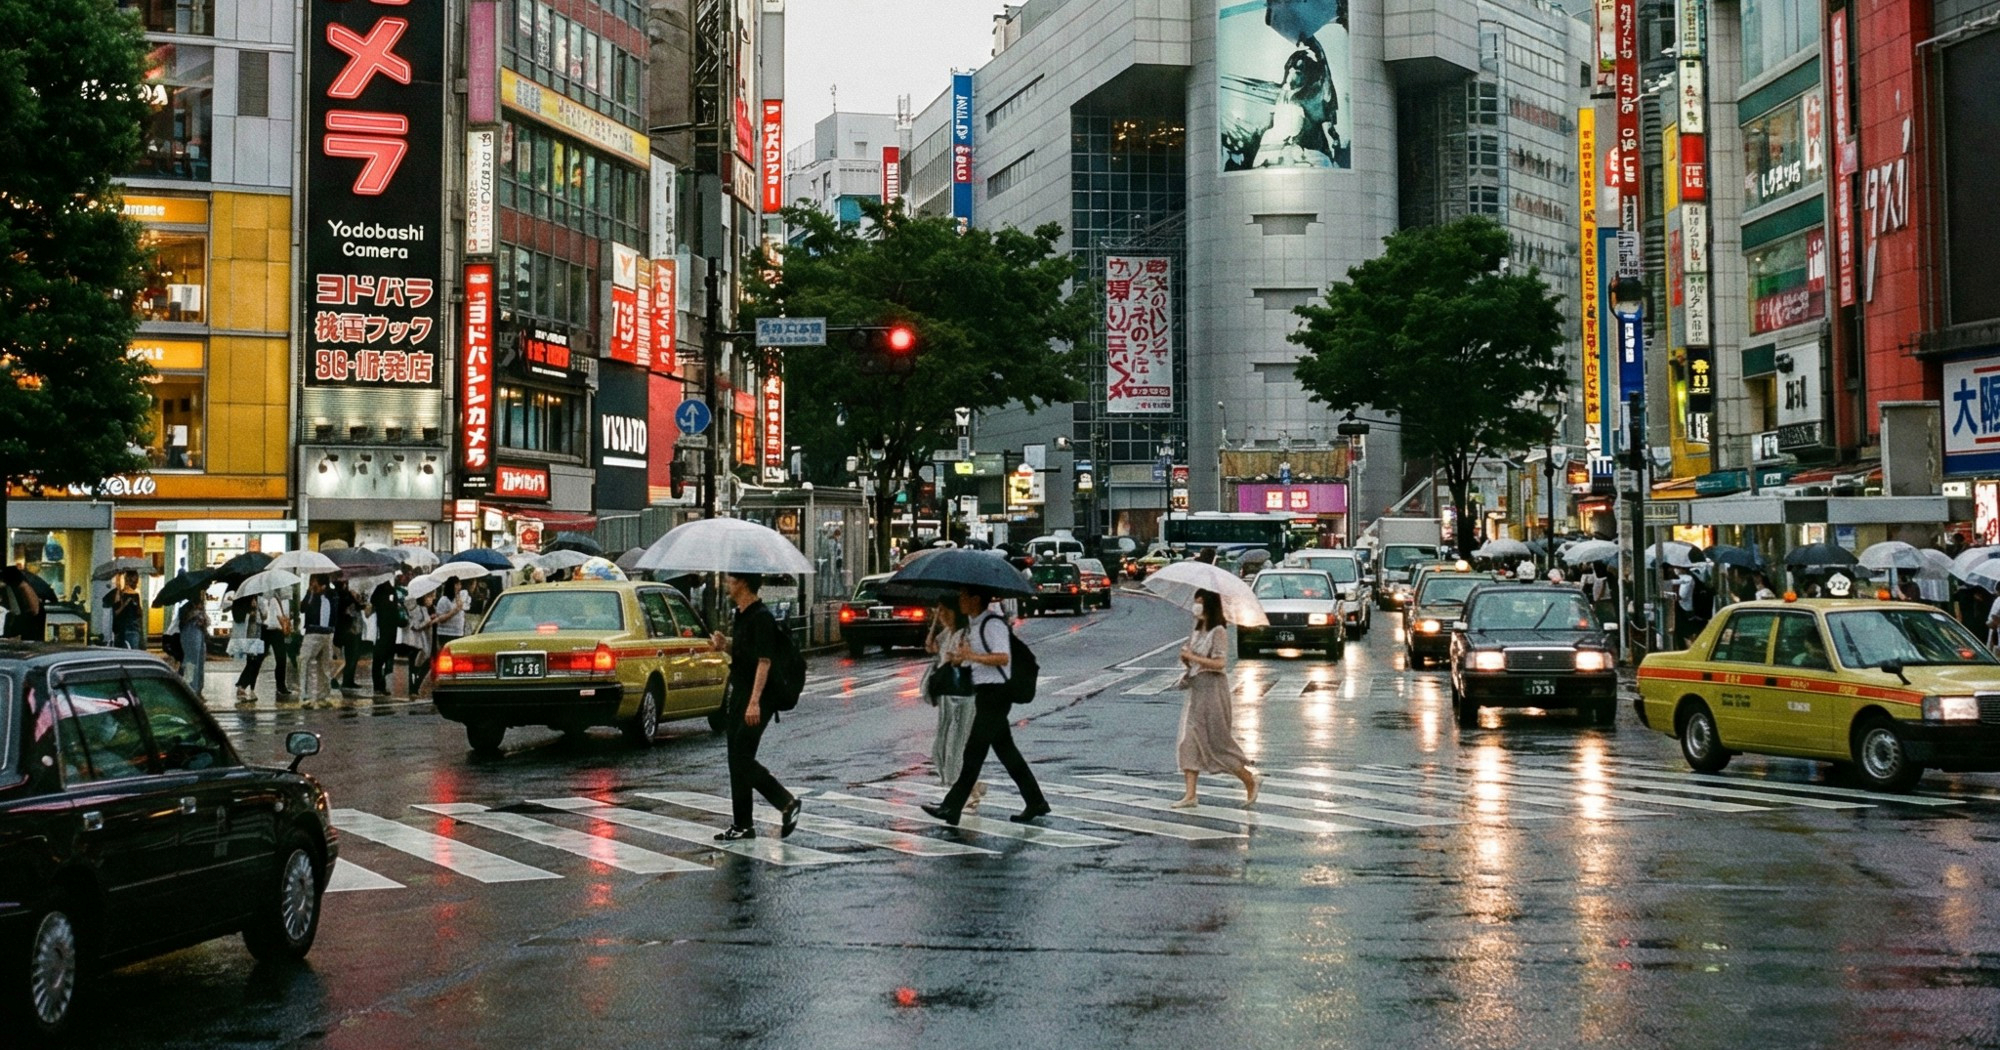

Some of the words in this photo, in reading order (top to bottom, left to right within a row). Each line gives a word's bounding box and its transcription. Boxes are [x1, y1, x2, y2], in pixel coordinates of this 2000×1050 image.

[324, 0, 411, 196] メラ
[328, 219, 425, 241] Yodobashi
[342, 241, 408, 259] Camera
